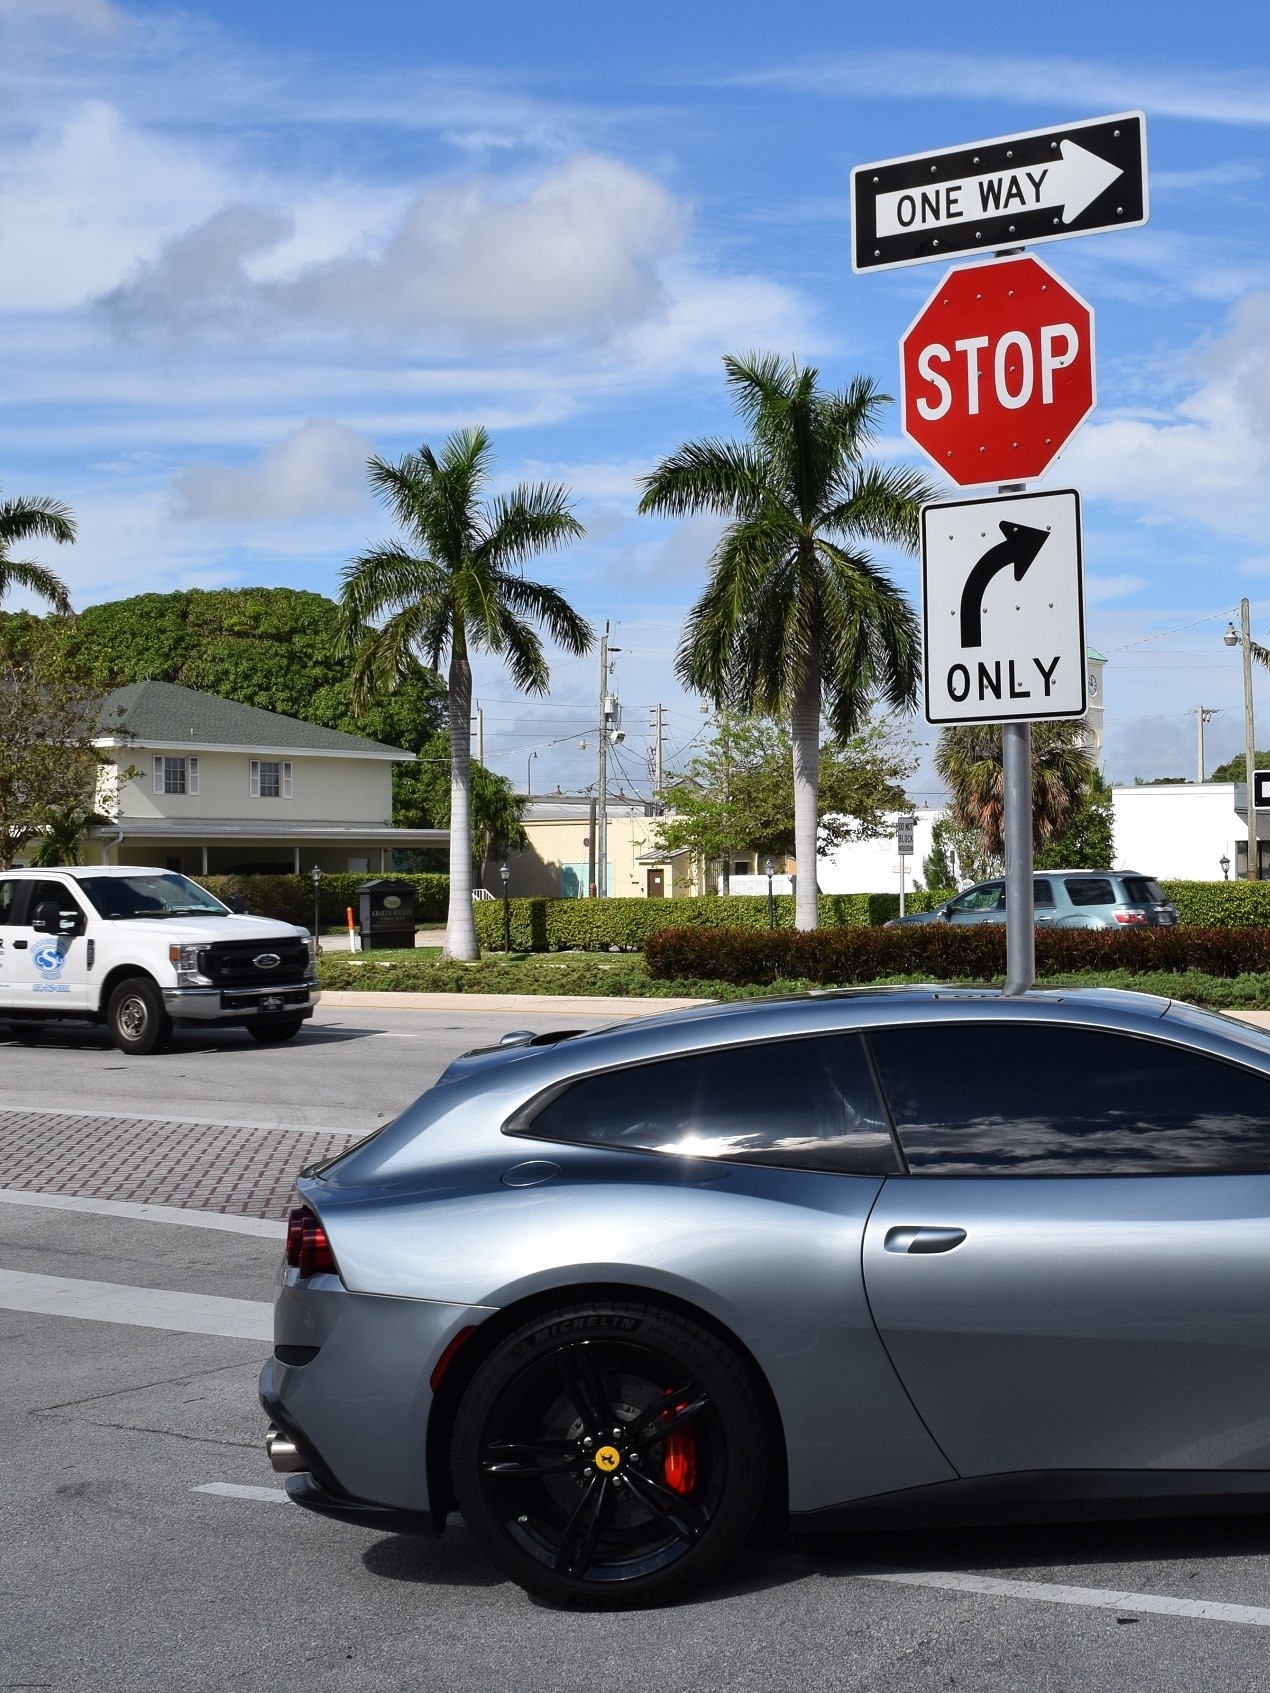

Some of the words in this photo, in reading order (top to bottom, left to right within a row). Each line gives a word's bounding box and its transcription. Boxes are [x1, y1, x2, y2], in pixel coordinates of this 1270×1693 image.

[897, 185, 963, 227] ONE
[978, 169, 1049, 212] WAY
[916, 322, 1079, 421] STOP
[947, 656, 1061, 702] ONLY
[899, 822, 904, 831] DO
[899, 834, 913, 844] BLOCK
[534, 1315, 635, 1343] MICHELIN
